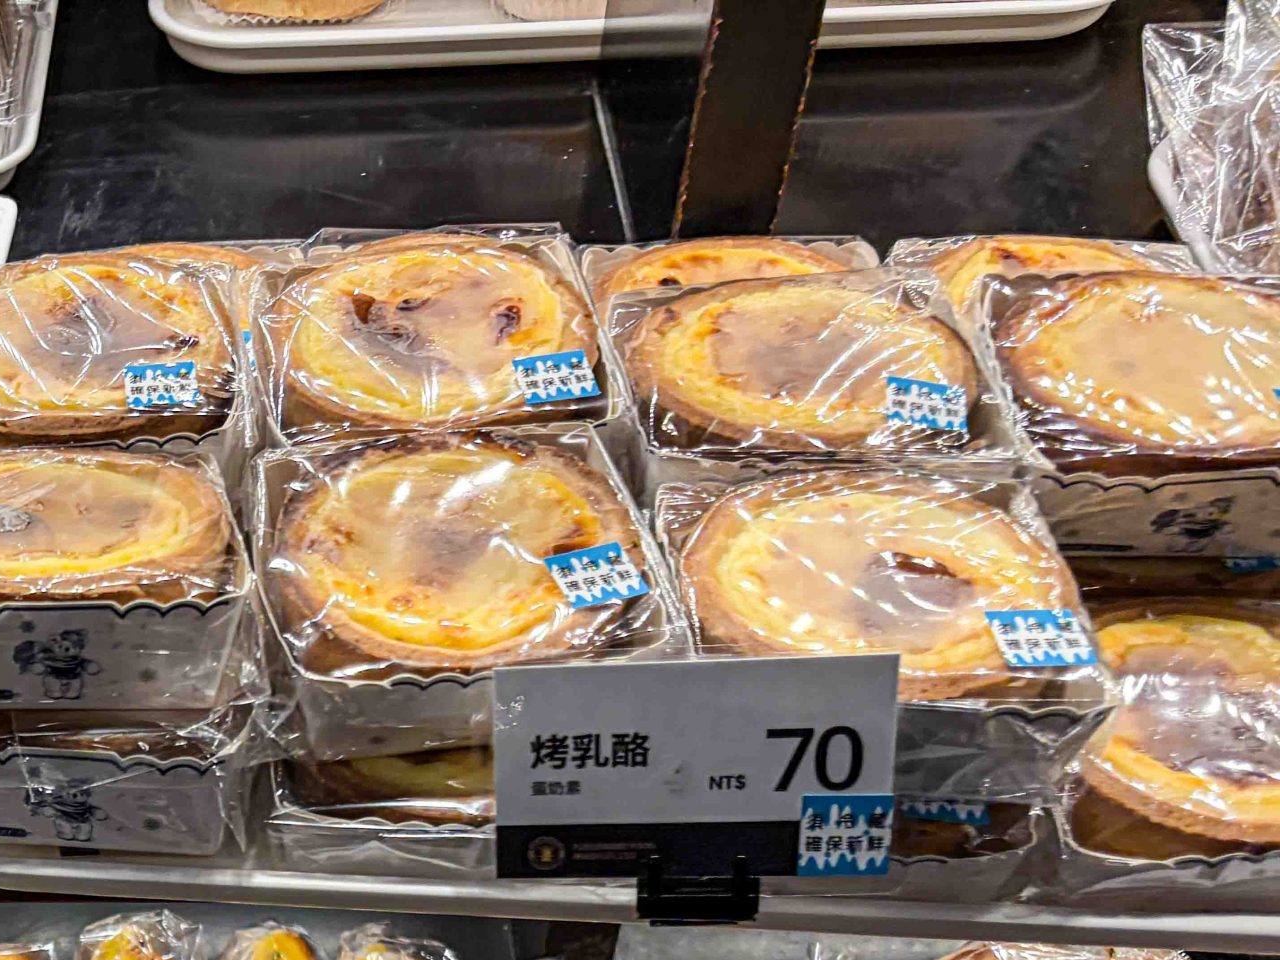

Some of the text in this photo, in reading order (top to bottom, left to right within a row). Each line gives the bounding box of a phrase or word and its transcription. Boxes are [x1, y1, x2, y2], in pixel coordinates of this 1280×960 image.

[530, 733, 651, 770] 烤乳酪
[709, 726, 864, 792] NT$ 70
